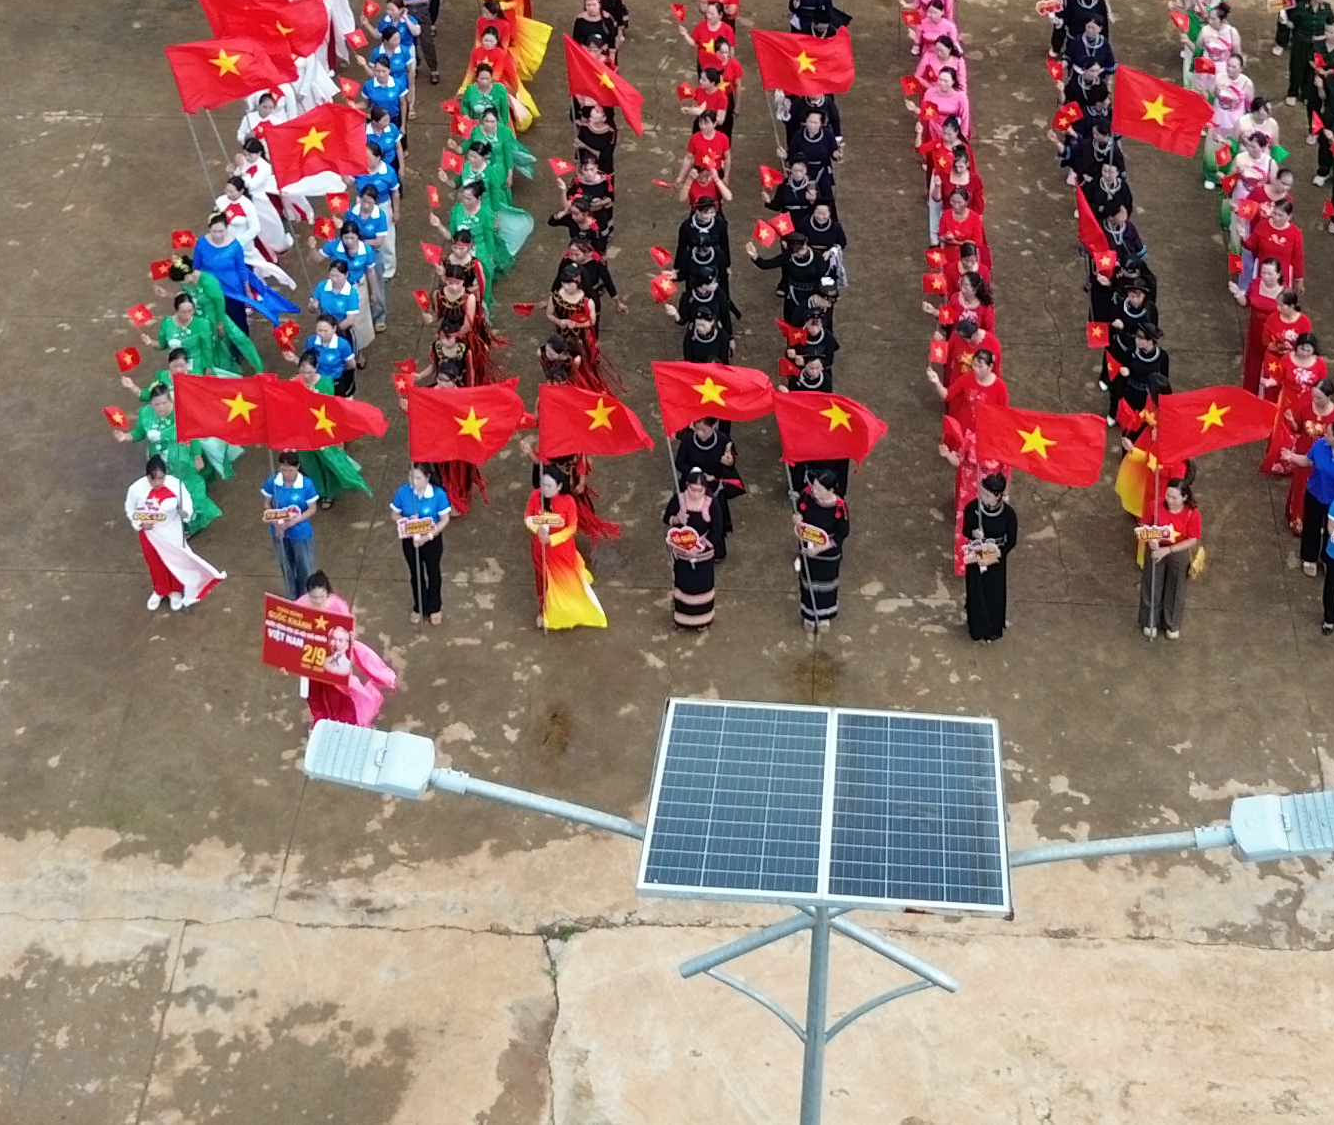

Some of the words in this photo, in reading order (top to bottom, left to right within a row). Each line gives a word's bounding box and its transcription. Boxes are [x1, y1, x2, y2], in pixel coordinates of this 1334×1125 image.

[267, 628, 285, 642] VIỆT
[285, 634, 304, 648] NAM
[301, 644, 327, 665] 2/9
